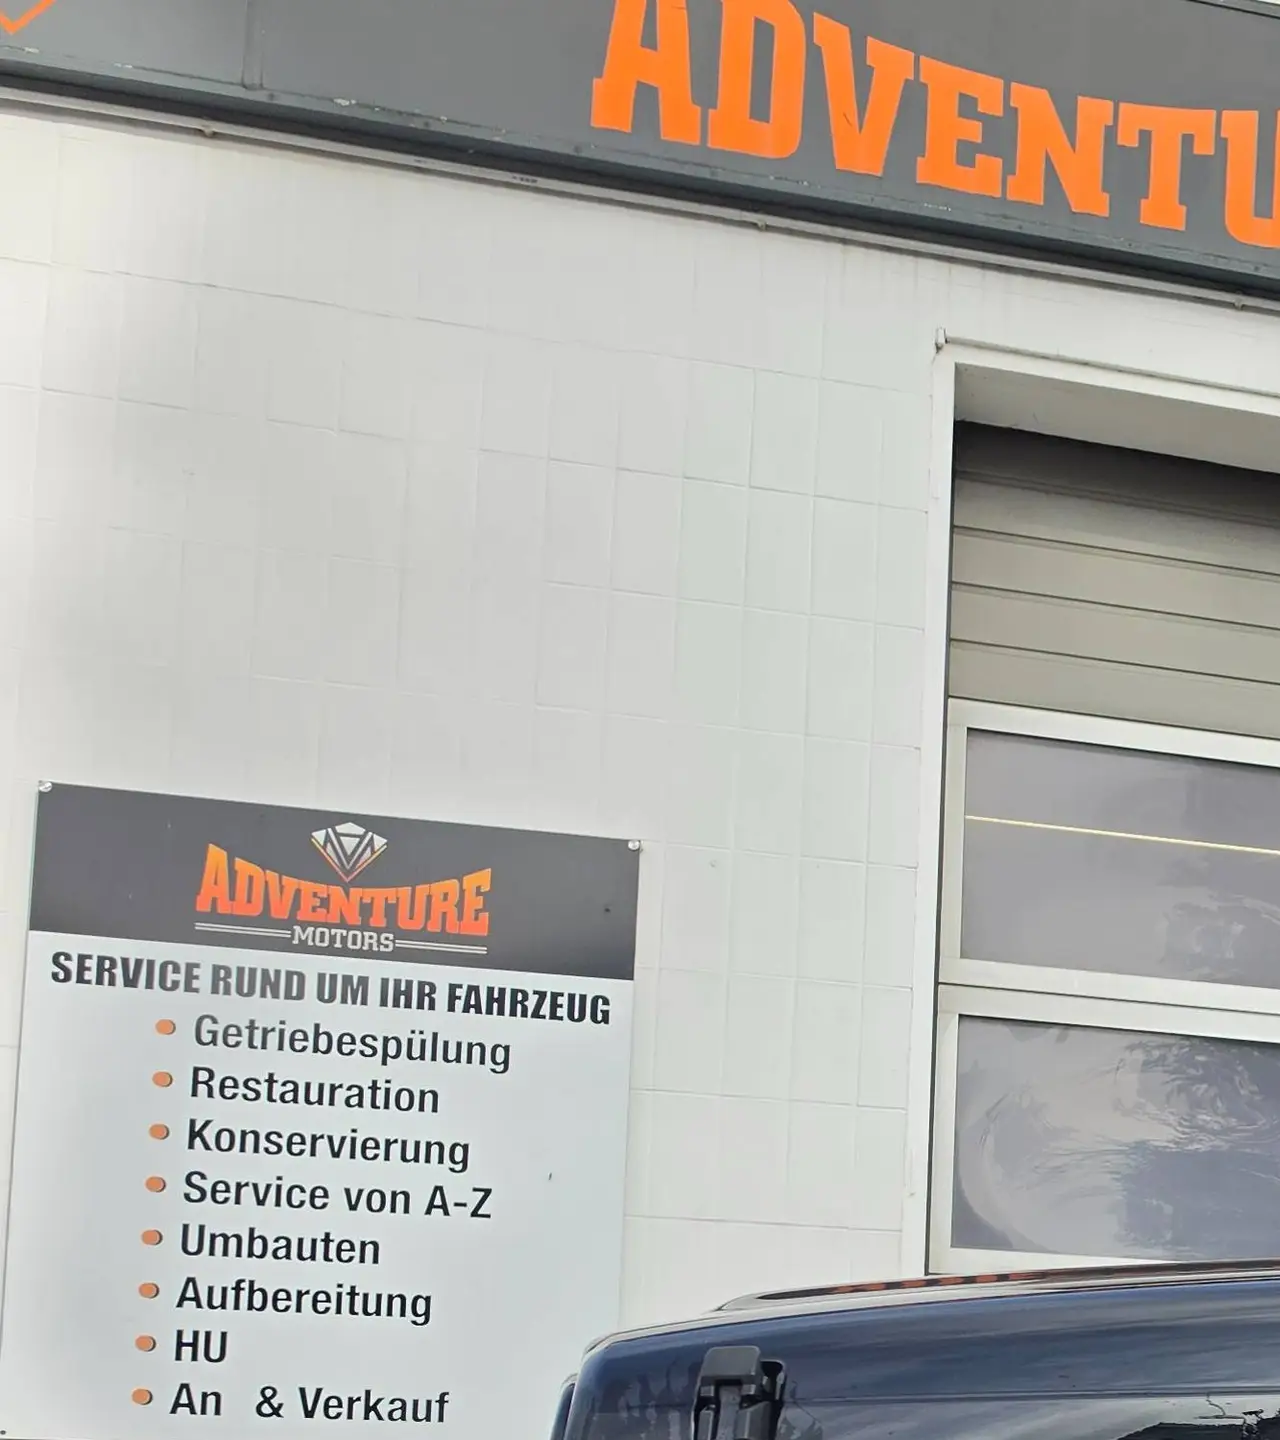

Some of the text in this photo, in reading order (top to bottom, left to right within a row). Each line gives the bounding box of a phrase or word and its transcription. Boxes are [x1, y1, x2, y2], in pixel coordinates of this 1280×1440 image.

[194, 842, 492, 937] ADVENTURE
[291, 925, 395, 953] MOTORS
[50, 951, 611, 1025] SERVICE RUND UM IHR FAHRZEUG
[193, 1014, 512, 1074] Getriebespülung
[190, 1066, 440, 1114] Restauration
[186, 1118, 471, 1173] Konservierung
[183, 1170, 493, 1219] Service von A-Z
[180, 1223, 381, 1266] Umbauten
[176, 1276, 433, 1326] Aufbereitung
[174, 1330, 229, 1364] HU
[169, 1383, 450, 1424] An & Verkauf
